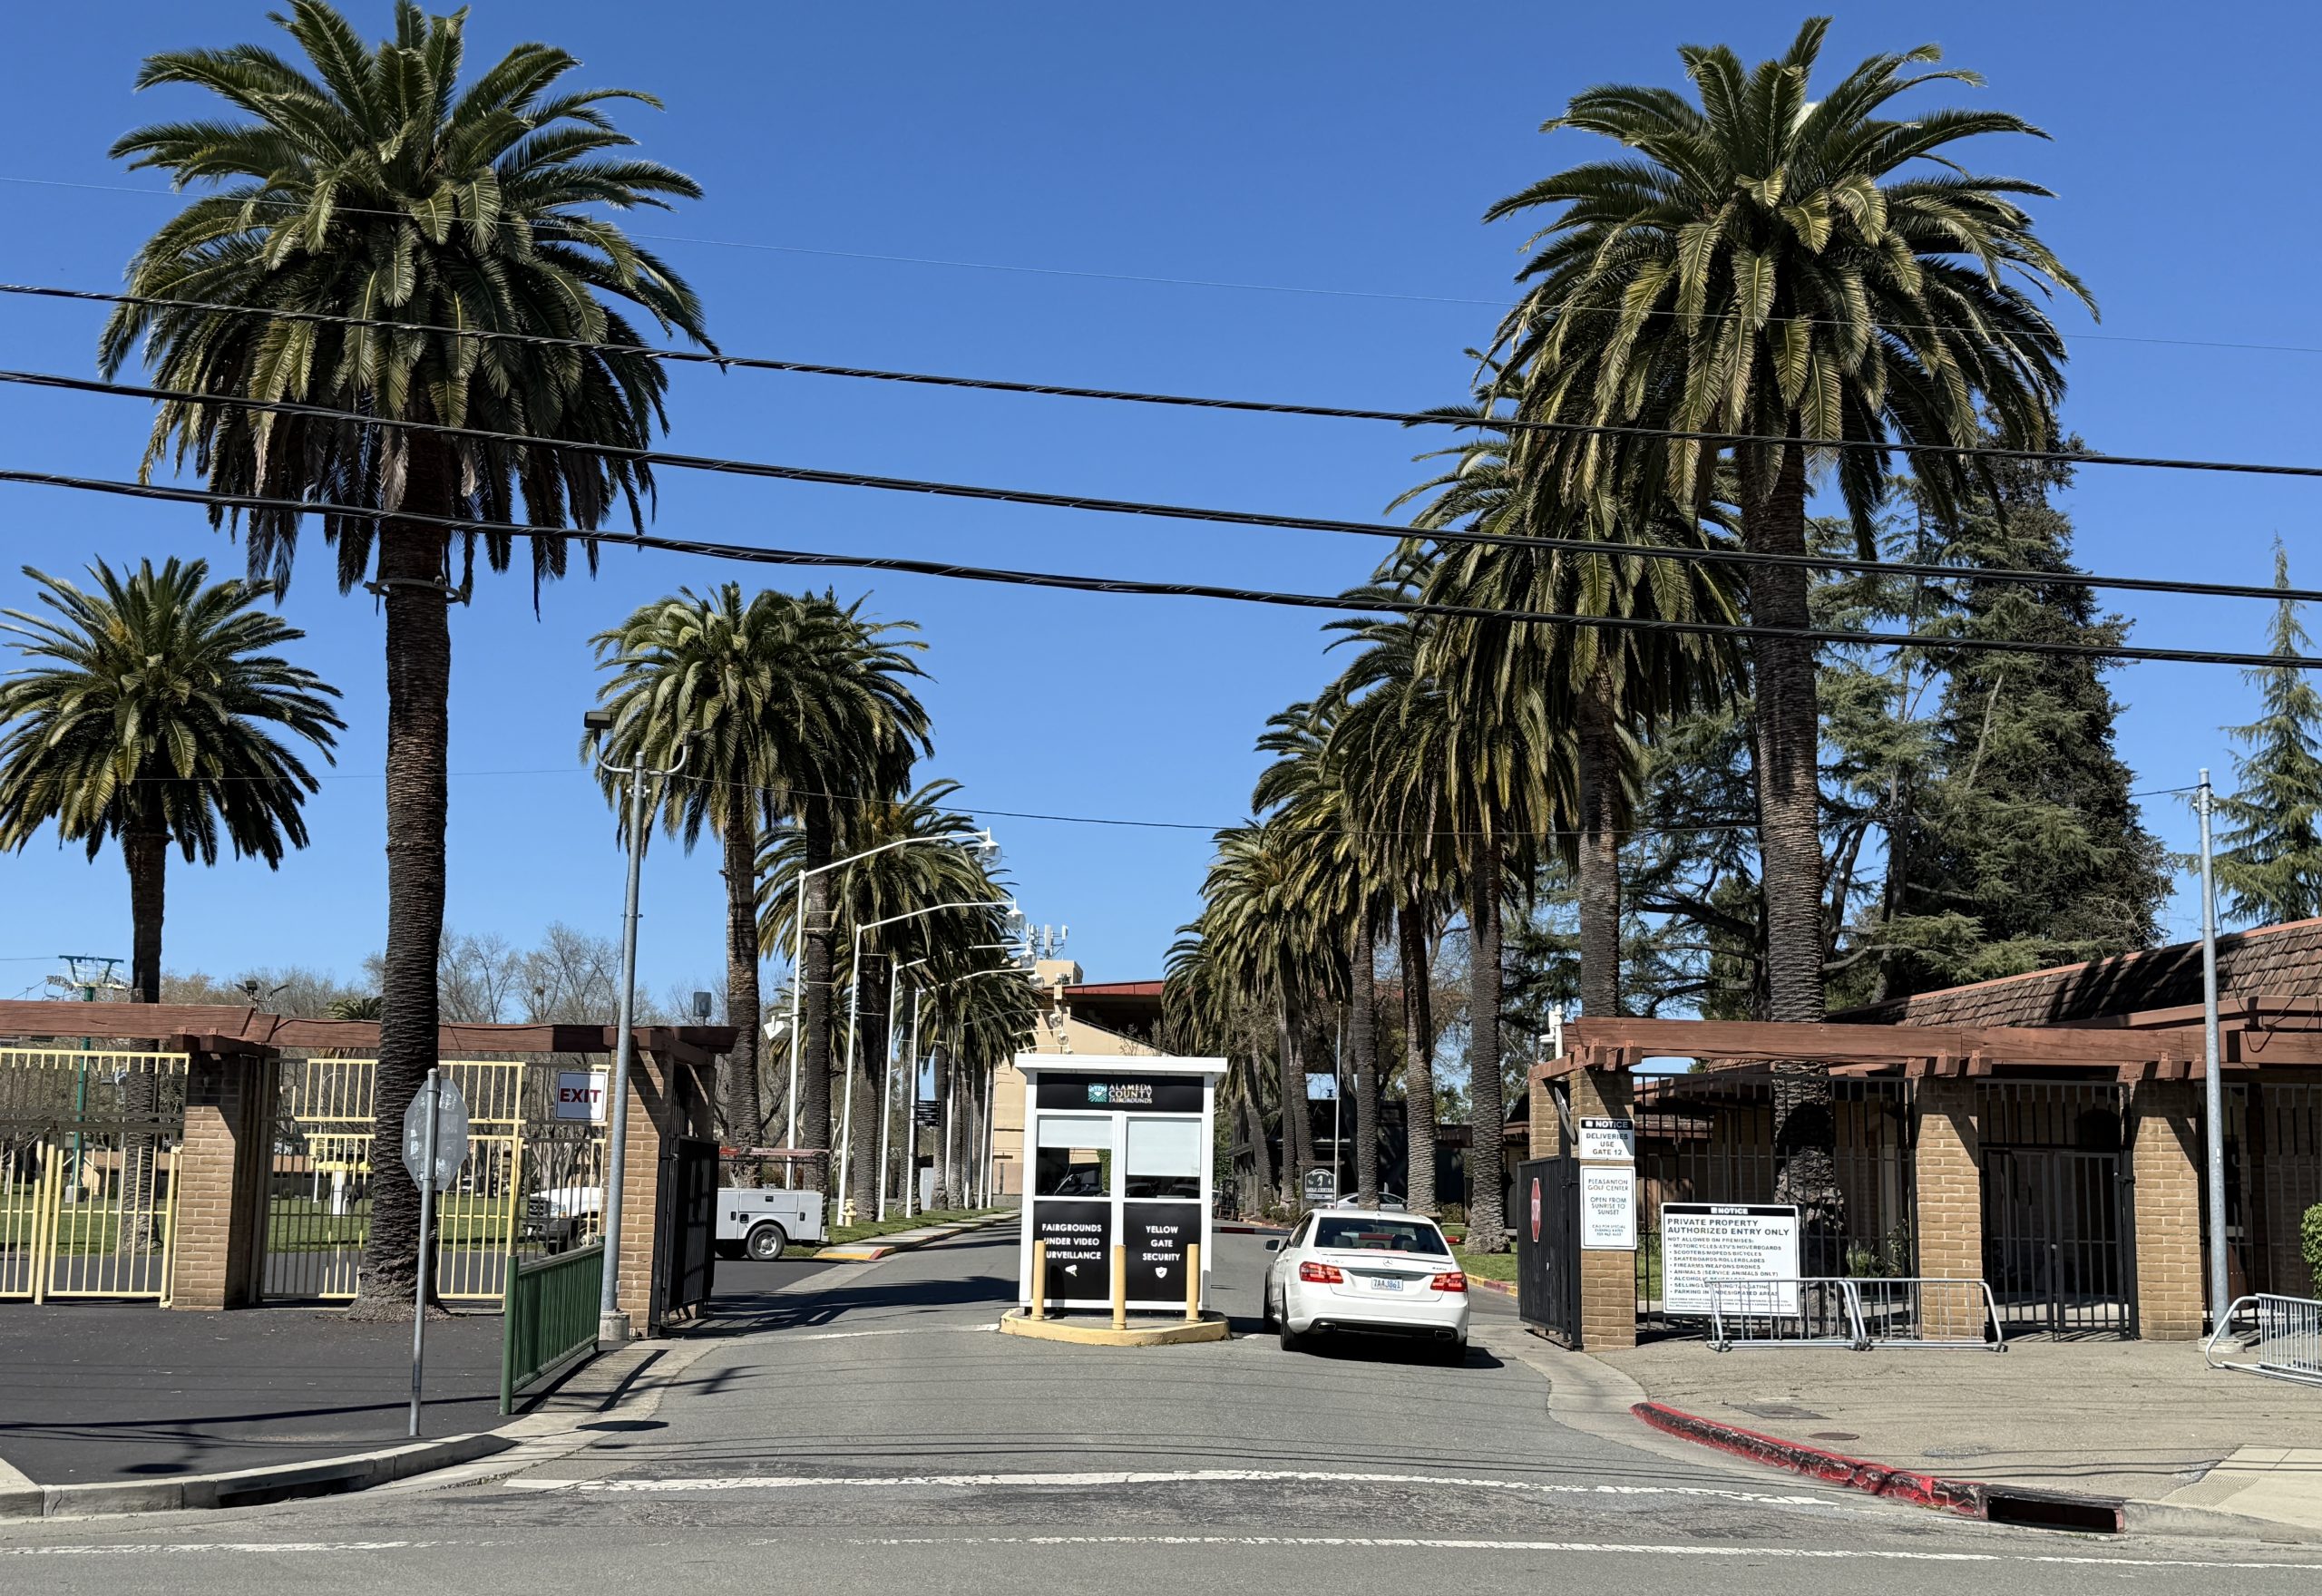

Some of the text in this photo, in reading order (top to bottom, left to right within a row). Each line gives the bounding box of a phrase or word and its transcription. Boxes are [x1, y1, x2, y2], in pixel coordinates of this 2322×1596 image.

[1109, 1083, 1152, 1091] ALAMEDA
[560, 1088, 601, 1103] EXIT
[1108, 1090, 1153, 1098] COUNTY
[1595, 1120, 1628, 1128] NOTICE
[1667, 1218, 1759, 1227] PRIVATE PROPERTY
[1041, 1223, 1102, 1232] FAIRGROUNDS
[1146, 1225, 1179, 1234] YELLOW
[1044, 1237, 1100, 1246] UNDER VIDEO
[1150, 1239, 1174, 1248] GATE
[1046, 1251, 1101, 1260] URVEILLANCE
[1142, 1252, 1181, 1261] SECURITY
